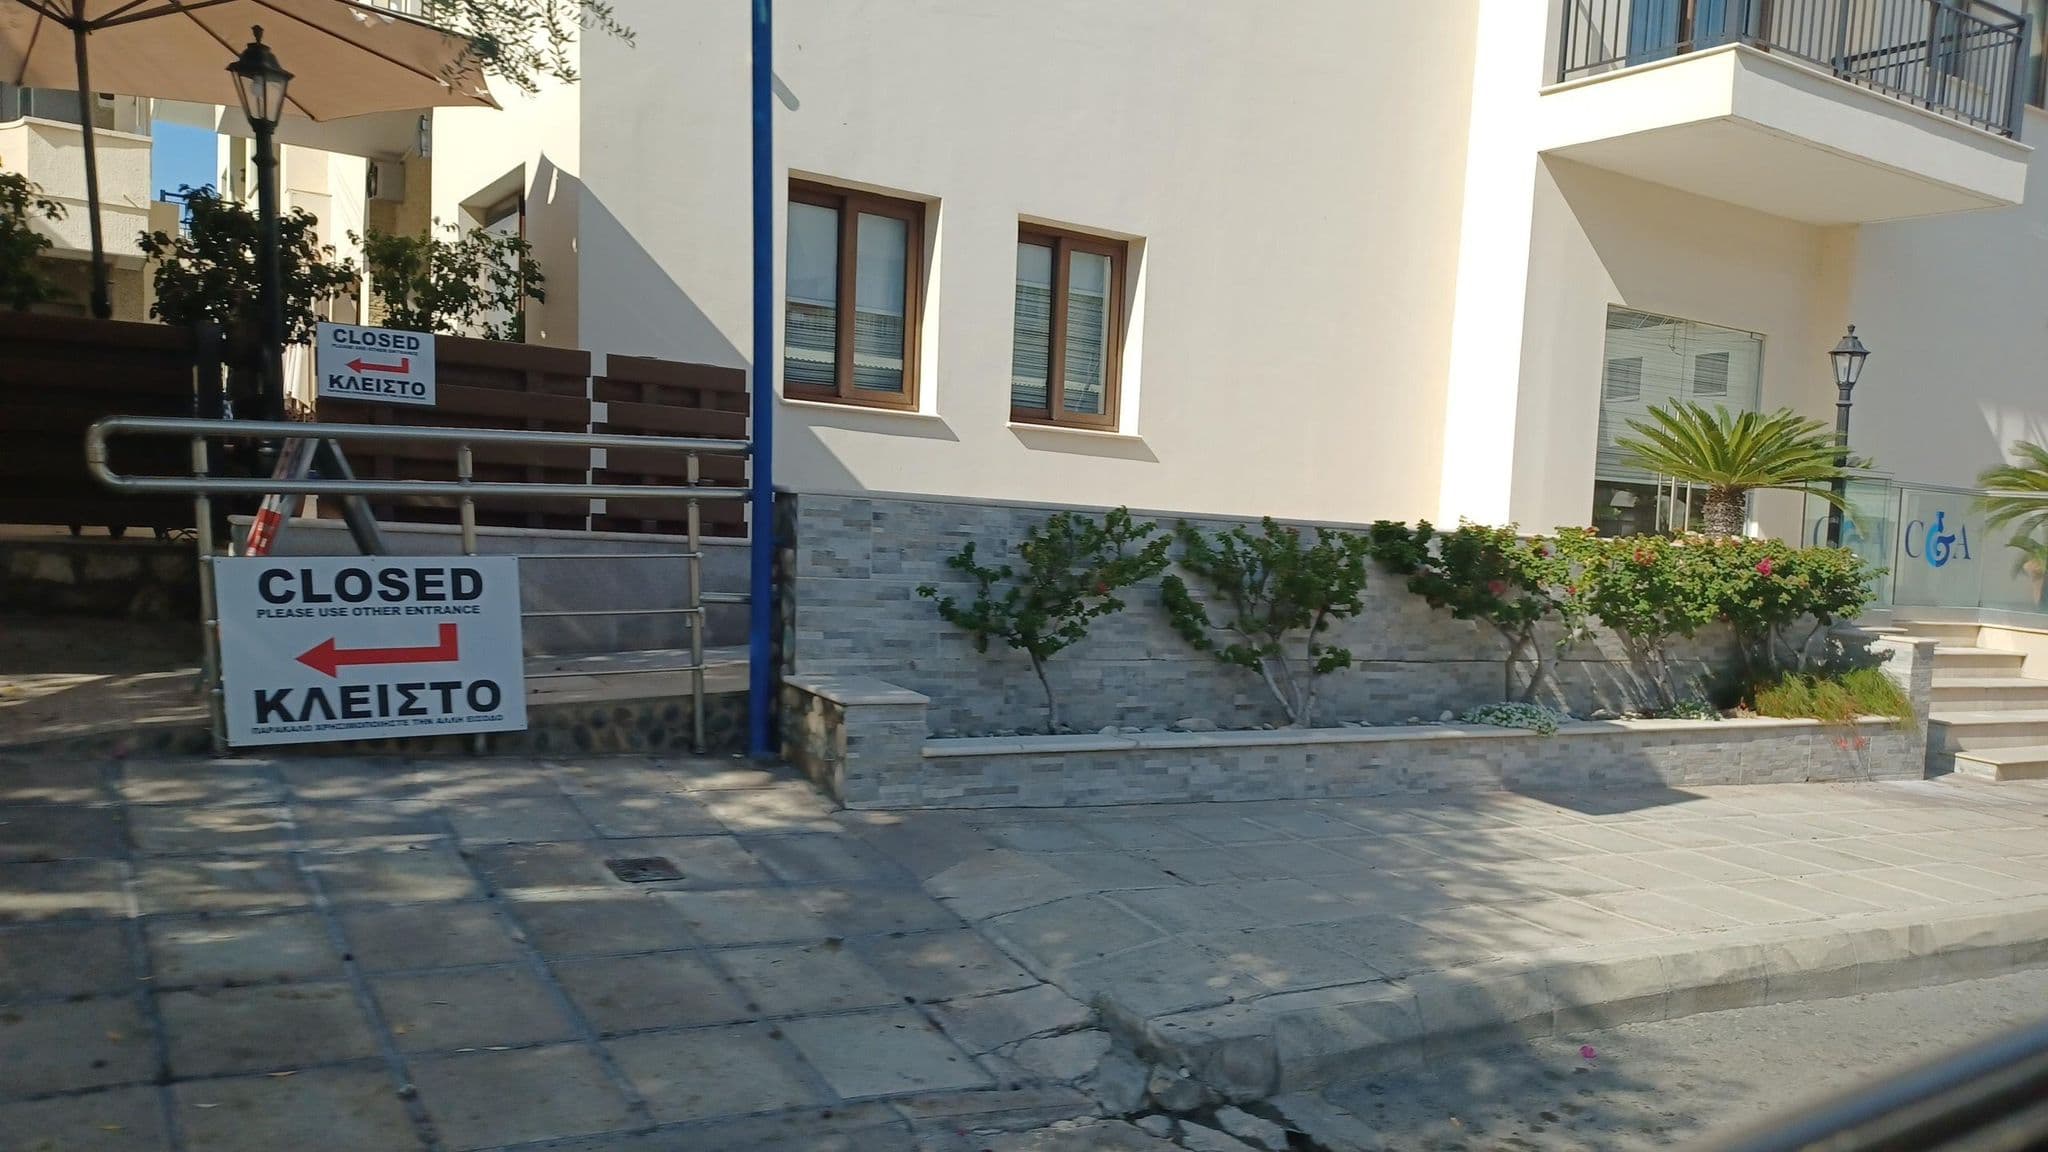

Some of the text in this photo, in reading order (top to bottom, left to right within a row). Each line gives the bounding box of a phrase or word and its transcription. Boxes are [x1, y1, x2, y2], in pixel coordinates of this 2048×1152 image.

[332, 328, 420, 351] CLOSED
[328, 374, 426, 396] ΚΛΕΙΣΤΟ
[258, 567, 484, 605] CLOSED
[256, 604, 481, 618] PLEASE USE OTHER ENTRANCE
[253, 679, 502, 724] ΚΛΕΙΣΤΟ
